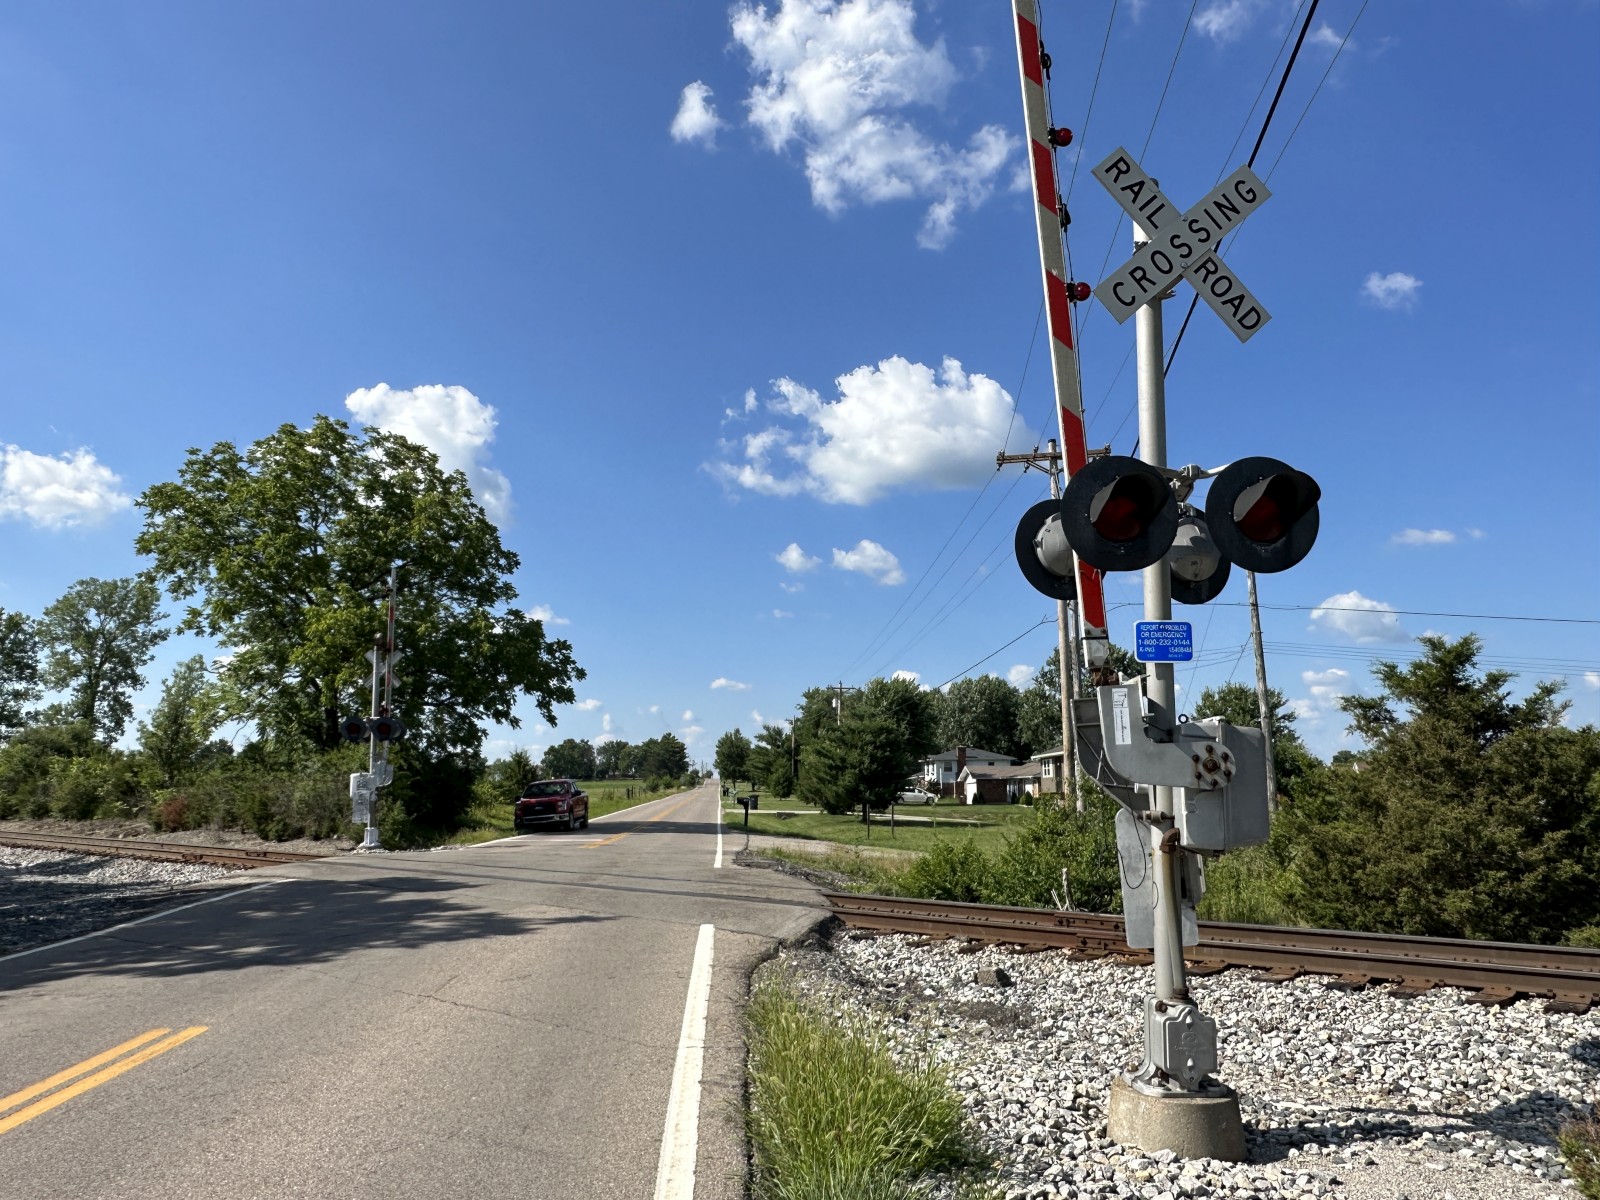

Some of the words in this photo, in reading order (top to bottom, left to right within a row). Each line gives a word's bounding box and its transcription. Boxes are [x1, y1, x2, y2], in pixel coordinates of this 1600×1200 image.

[1104, 156, 1166, 230] RAIL
[1112, 179, 1257, 307] CROSSING
[1193, 256, 1262, 331] ROAD
